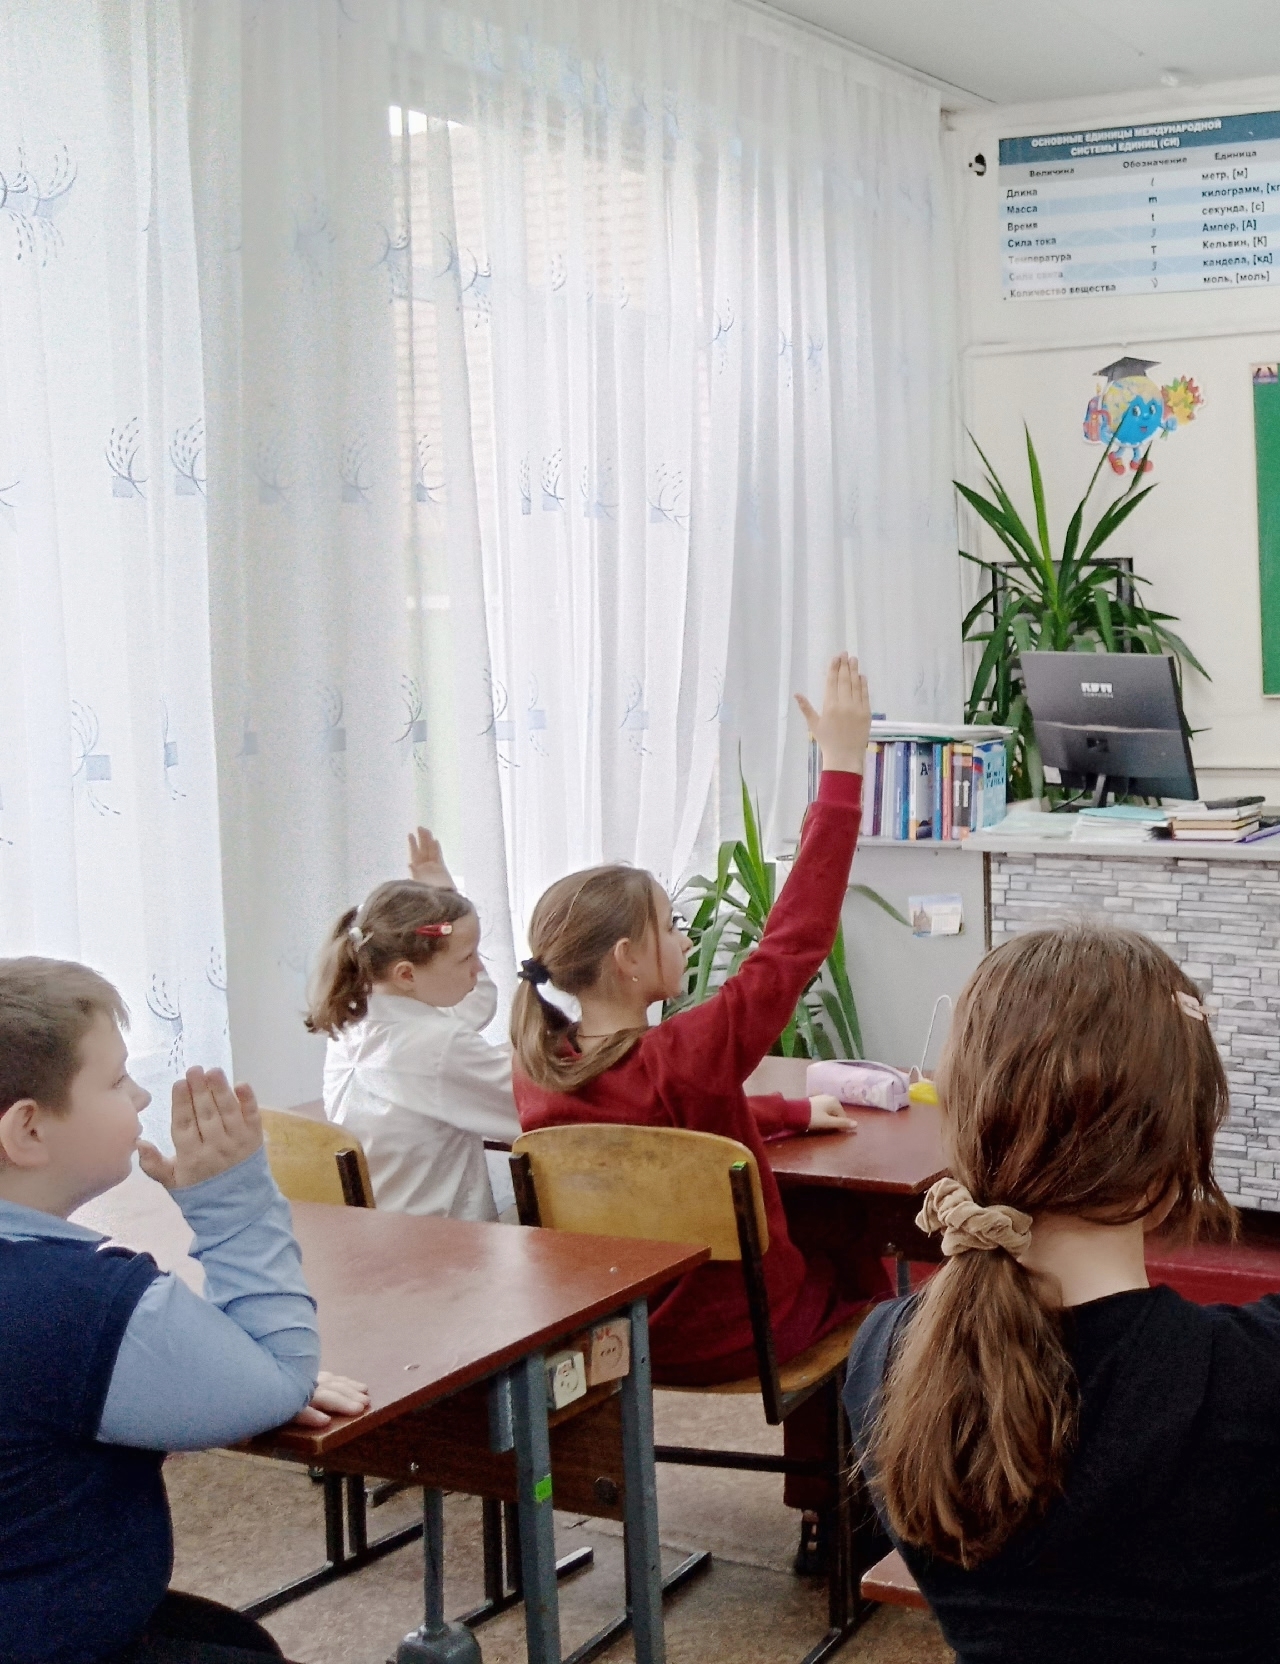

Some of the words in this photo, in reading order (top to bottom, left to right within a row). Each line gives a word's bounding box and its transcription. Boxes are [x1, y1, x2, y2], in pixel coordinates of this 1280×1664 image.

[1031, 134, 1083, 147] ОСНОВНЫЕ
[1085, 129, 1132, 143] ЕДИНИЦЫ
[1134, 119, 1221, 137] МЕЖДУНАРОДНОЙ
[1070, 142, 1117, 156] СИСТЕМЫ
[1118, 138, 1158, 152] ЕДИНИЦ
[1159, 136, 1180, 149] (СИ)
[1029, 168, 1074, 177] Величина
[1122, 157, 1187, 169] Обозначение
[1214, 151, 1257, 160] Единица
[1006, 189, 1038, 198] Длина
[1007, 205, 1038, 214] Масса
[1007, 222, 1038, 232] Время
[1008, 239, 1032, 248] Сила
[1035, 236, 1057, 246] тока
[1008, 252, 1072, 264] Температура
[1069, 283, 1116, 294] вещества
